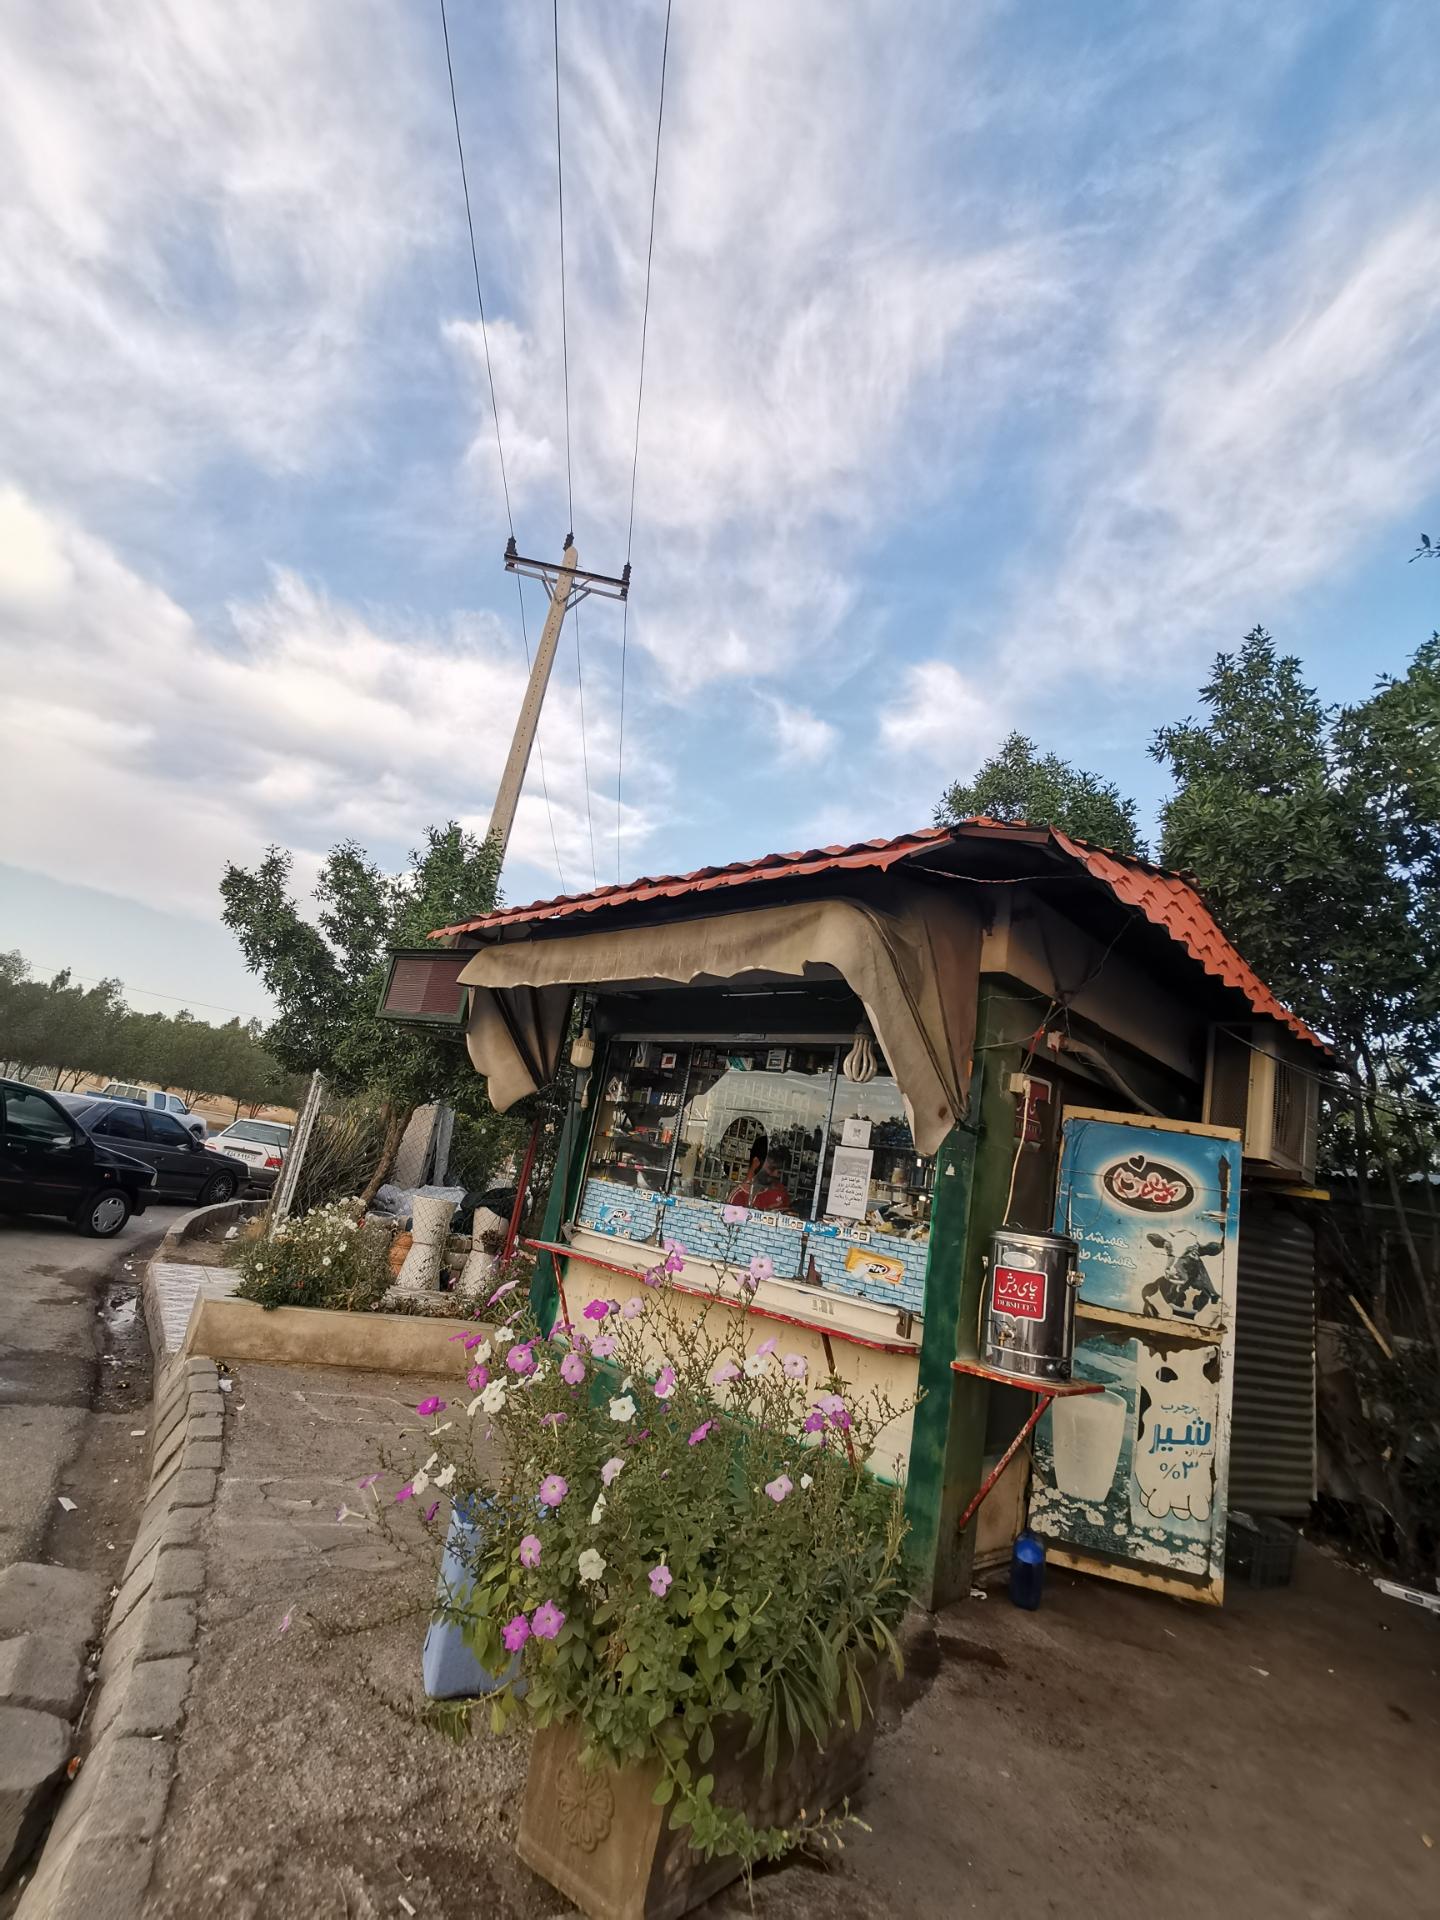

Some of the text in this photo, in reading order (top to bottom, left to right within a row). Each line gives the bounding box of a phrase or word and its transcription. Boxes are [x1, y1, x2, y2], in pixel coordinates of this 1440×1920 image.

[1085, 1231, 1129, 1249] همیشه
[1093, 1251, 1137, 1269] همیشه
[998, 1272, 1039, 1300] چای دبش
[1148, 1416, 1211, 1455] شیر
